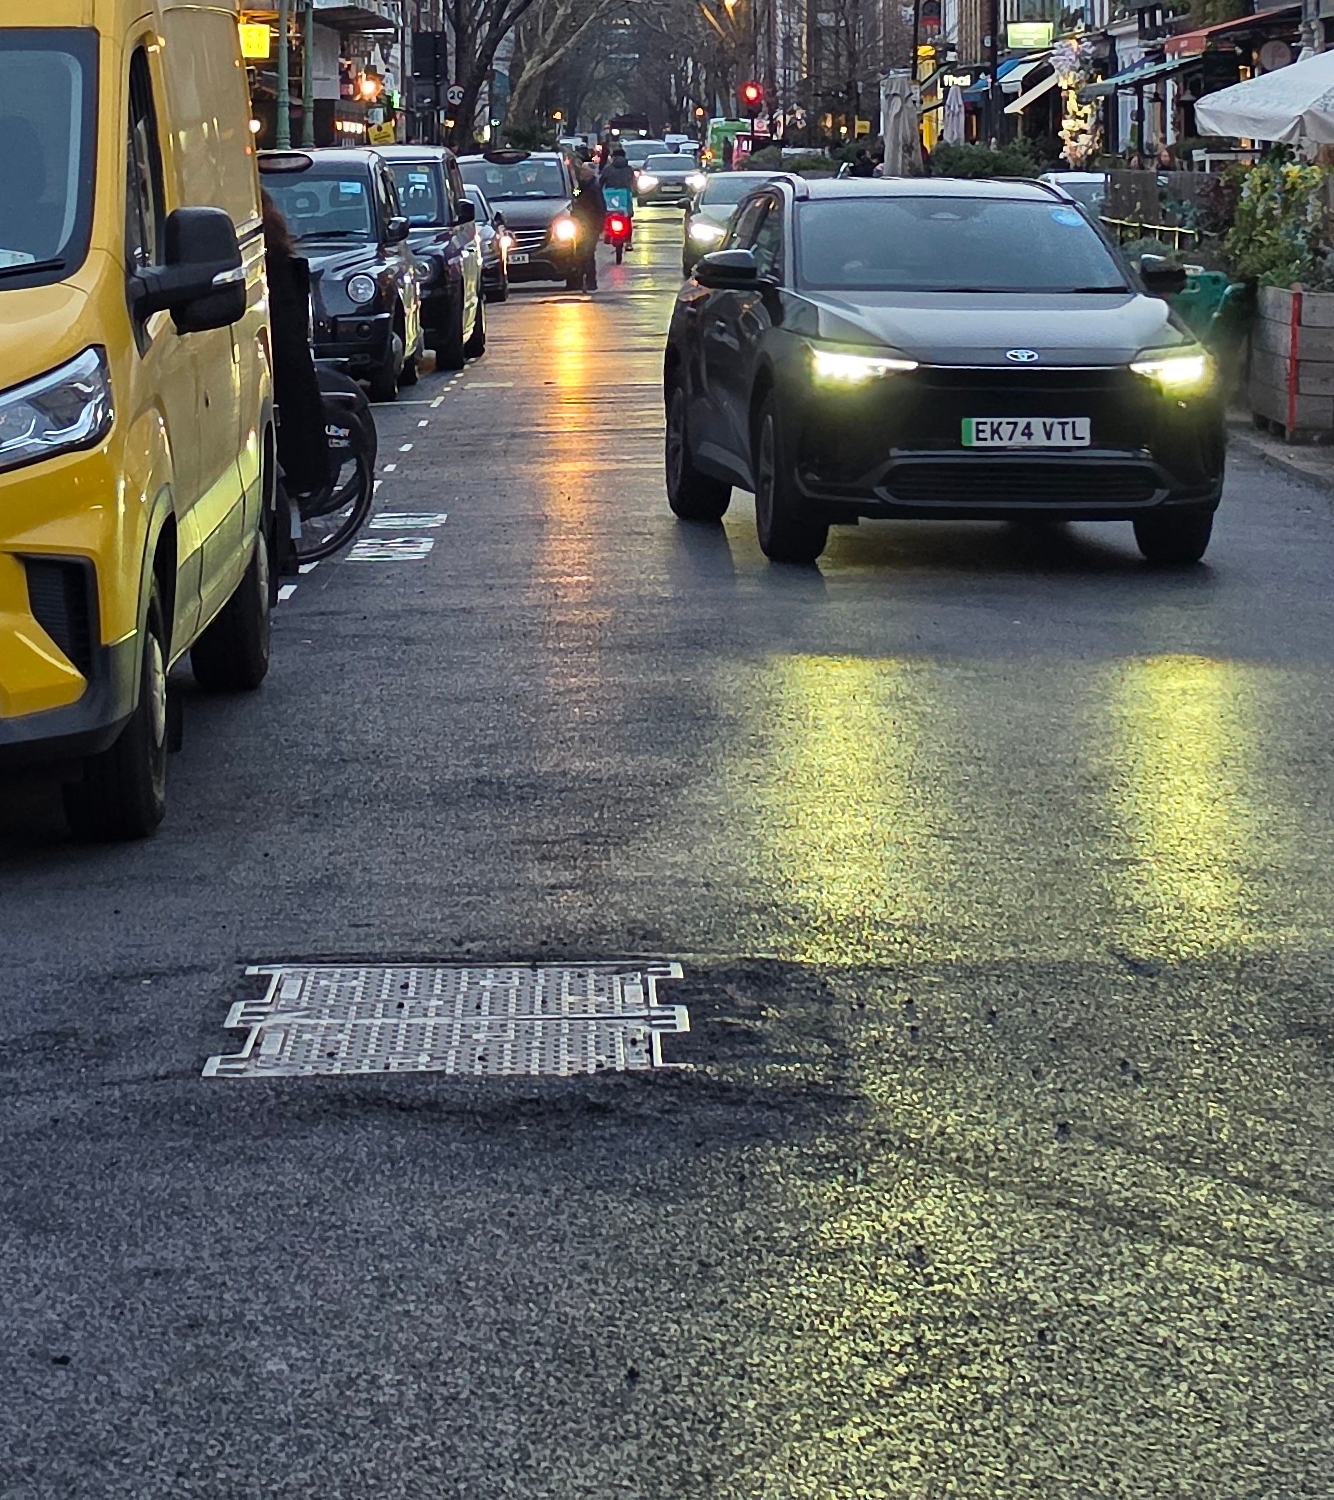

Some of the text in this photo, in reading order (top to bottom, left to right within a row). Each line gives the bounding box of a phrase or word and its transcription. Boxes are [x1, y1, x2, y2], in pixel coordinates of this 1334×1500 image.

[449, 90, 463, 100] 20
[975, 420, 1086, 442] EK74 VTL
